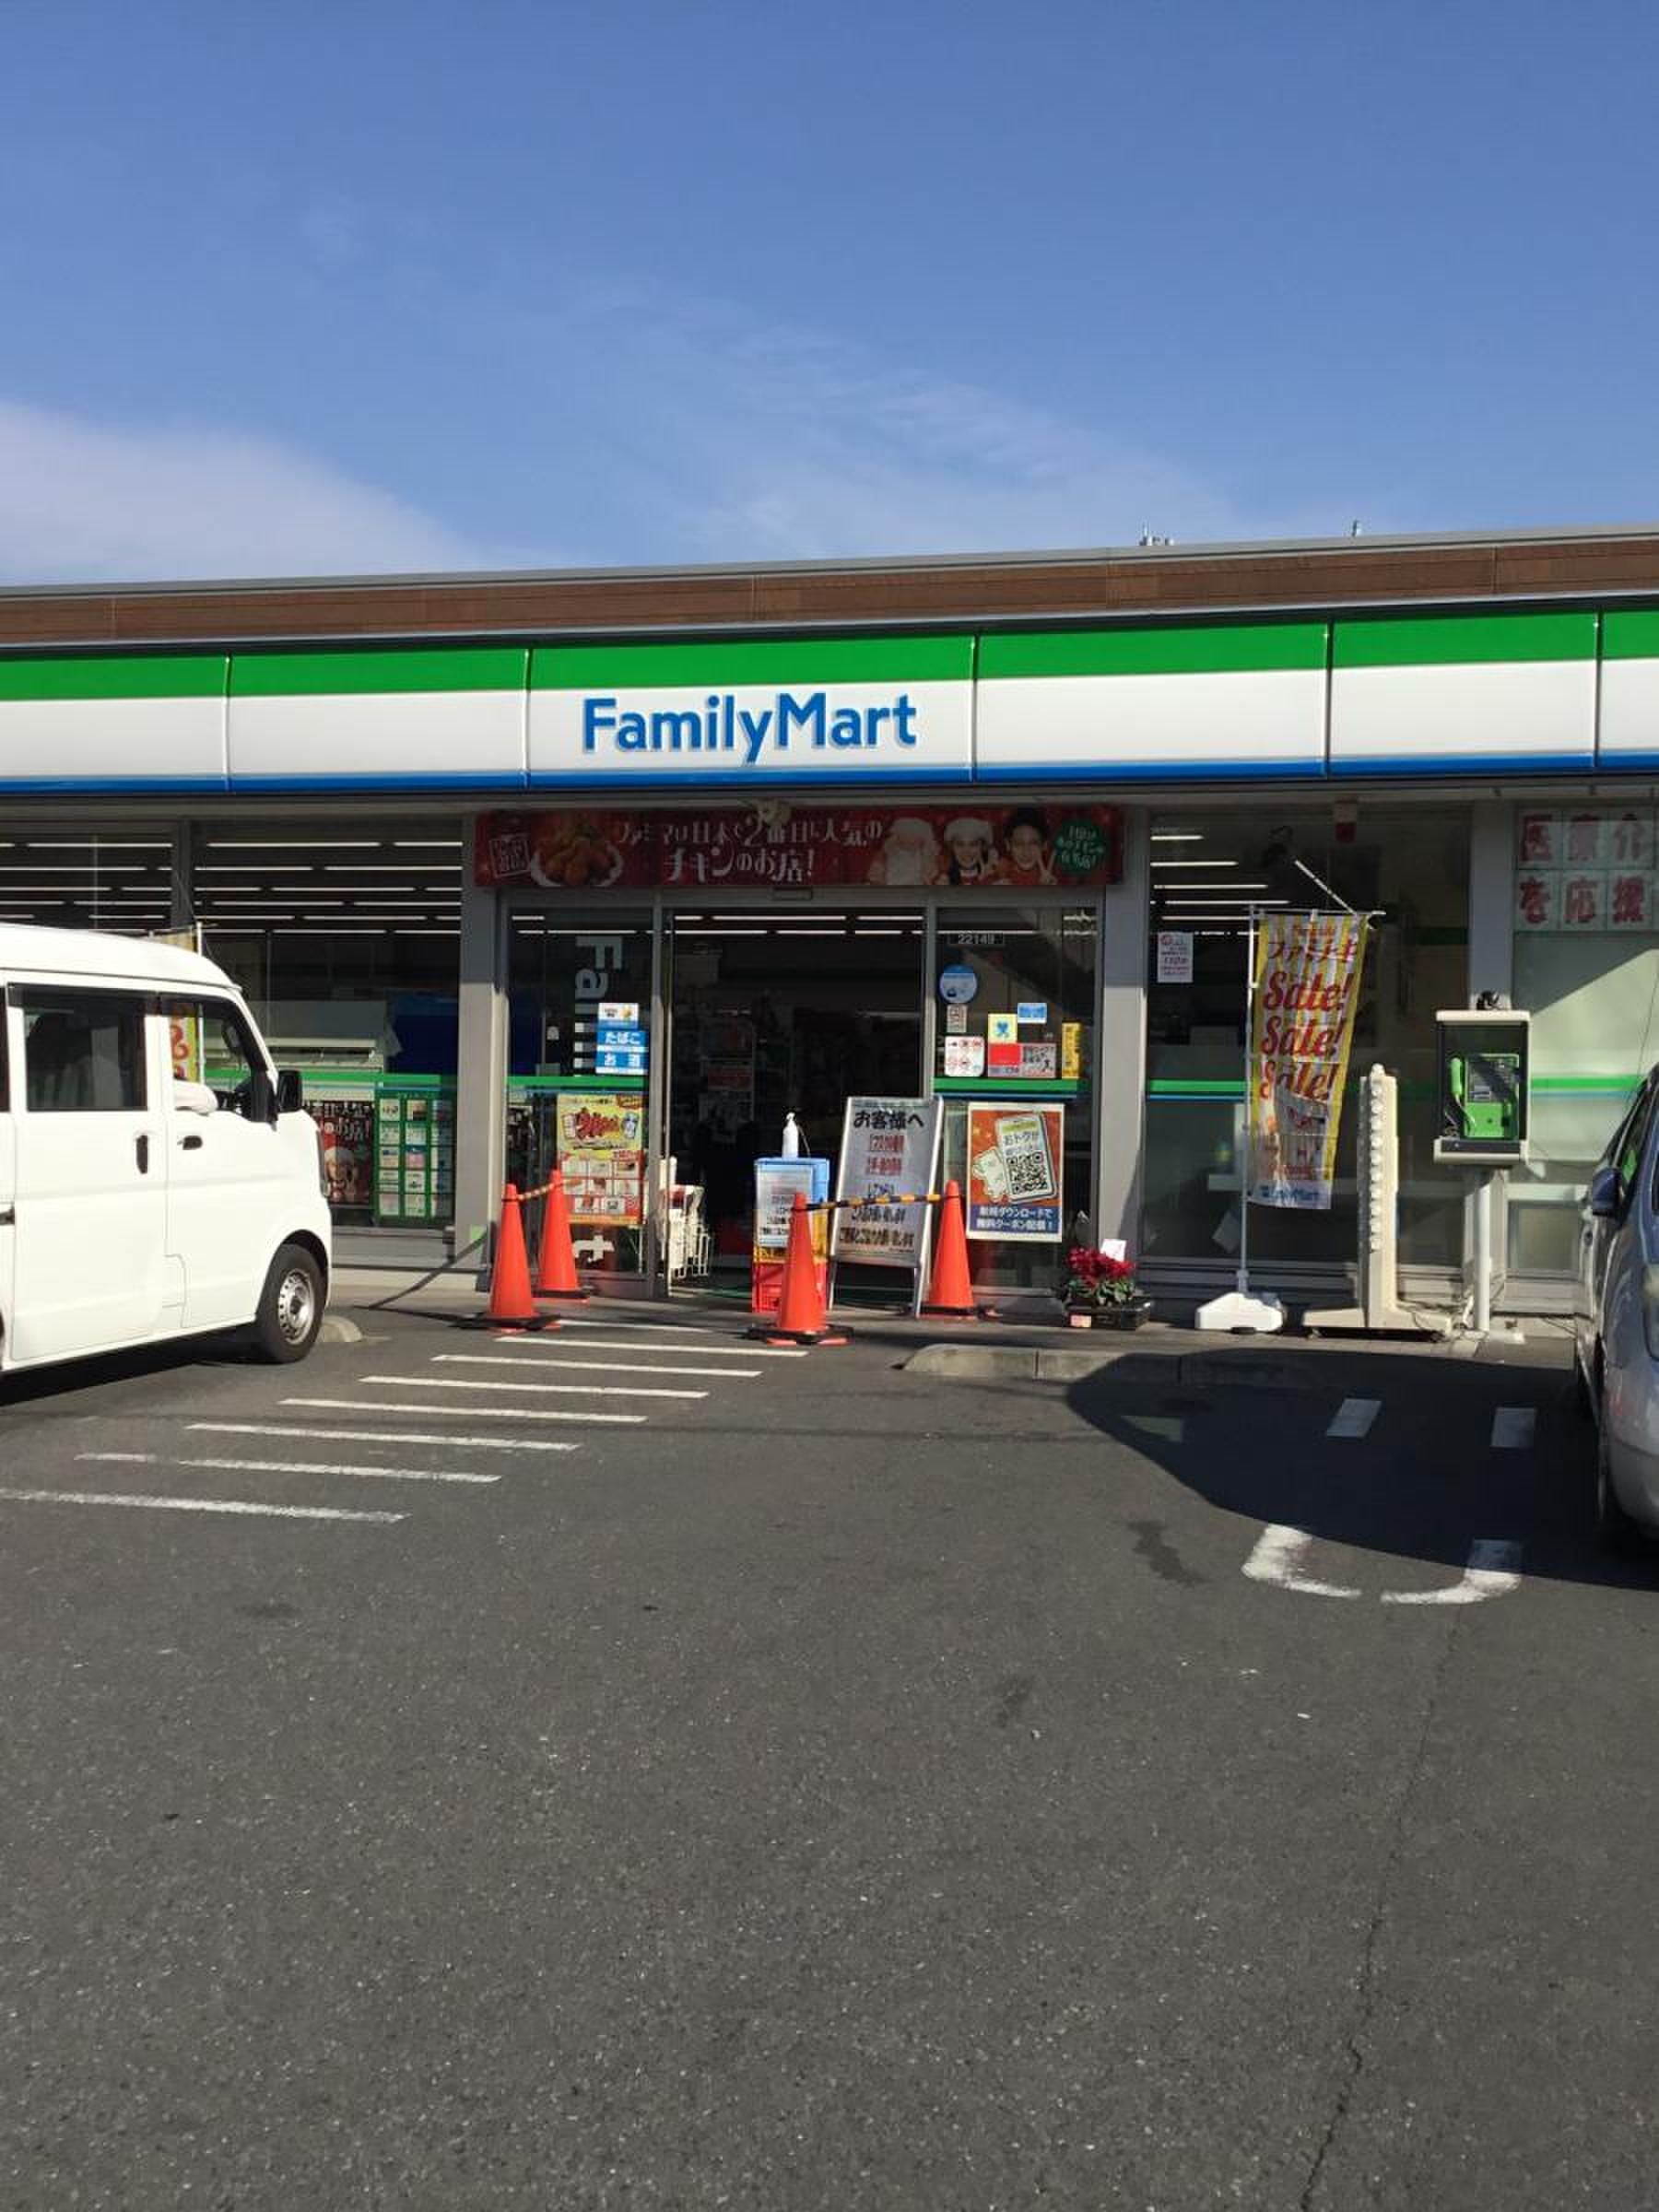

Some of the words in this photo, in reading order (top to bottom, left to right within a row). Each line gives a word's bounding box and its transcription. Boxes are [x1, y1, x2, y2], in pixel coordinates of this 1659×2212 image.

[583, 693, 917, 764] FamilyMart
[1263, 971, 1354, 1011] Sale!
[606, 1031, 641, 1045] たばこ
[1260, 1016, 1347, 1056] Sale!
[1259, 1061, 1339, 1100] Sale!
[853, 1111, 924, 1131] お客様へ
